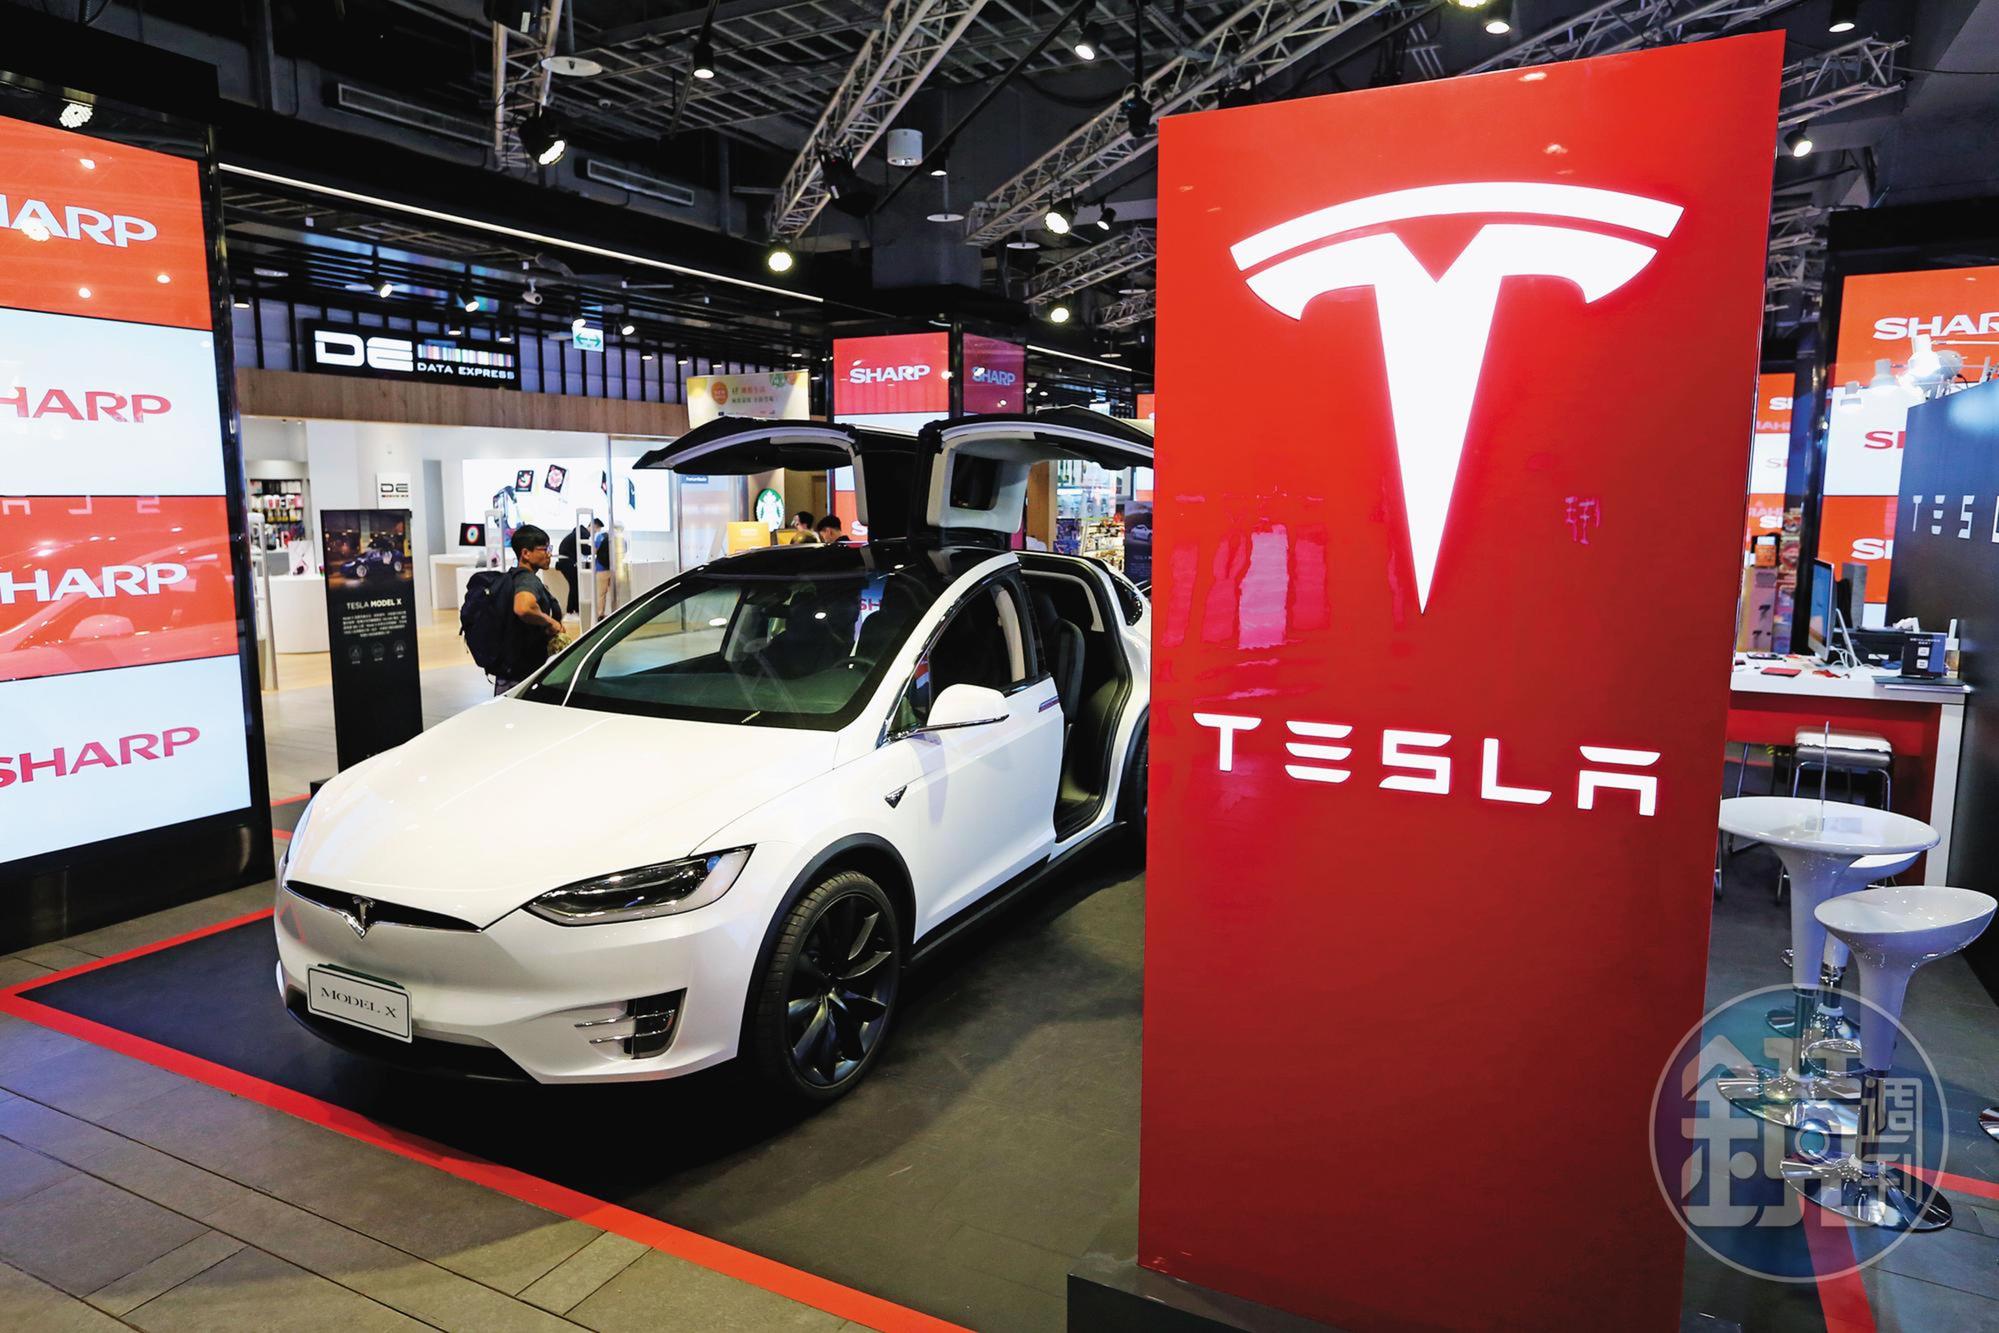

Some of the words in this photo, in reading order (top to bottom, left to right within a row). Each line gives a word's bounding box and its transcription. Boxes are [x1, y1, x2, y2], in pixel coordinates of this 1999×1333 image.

[0, 193, 158, 248] ARP
[314, 330, 414, 372] DE
[417, 362, 453, 374] DATA
[458, 366, 515, 380] EXPRESS
[850, 364, 931, 384] SHARP
[971, 366, 1016, 386] SHARP
[0, 563, 188, 605] HARP
[346, 602, 369, 610] TESLA
[370, 599, 395, 608] MODEL
[1193, 712, 1661, 817] TESLA
[321, 987, 381, 1013] MODEL
[385, 1006, 398, 1019] X
